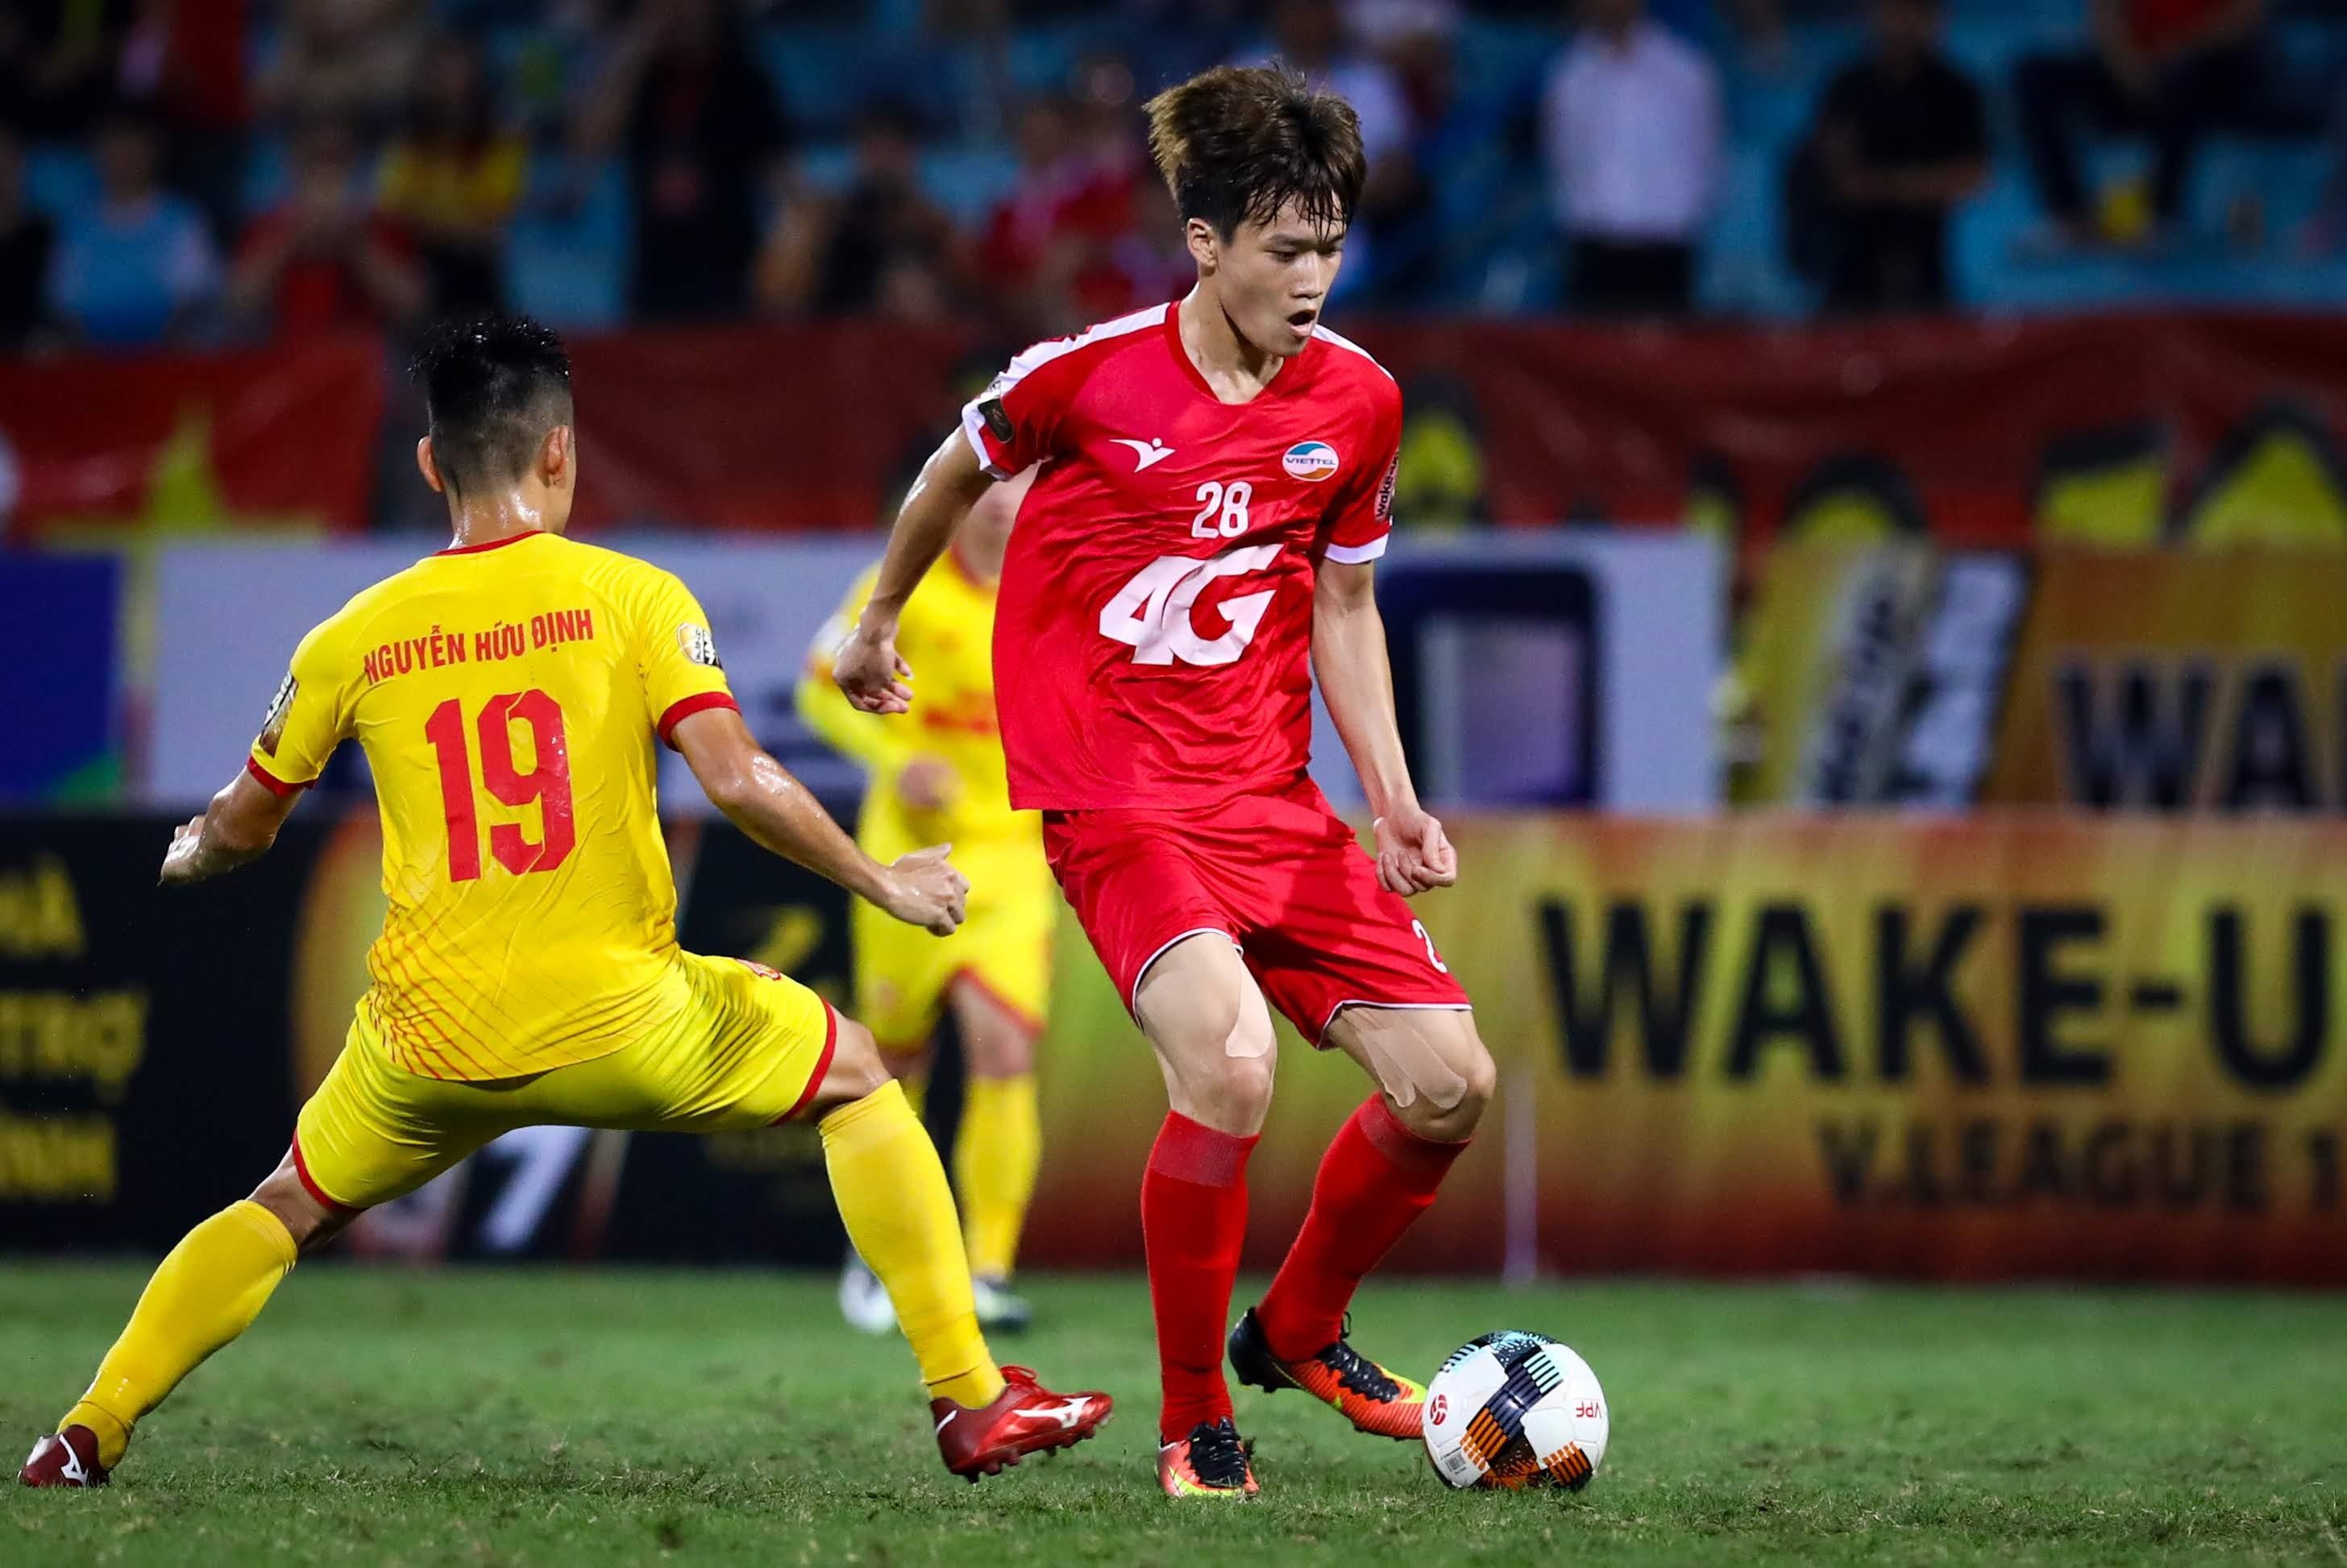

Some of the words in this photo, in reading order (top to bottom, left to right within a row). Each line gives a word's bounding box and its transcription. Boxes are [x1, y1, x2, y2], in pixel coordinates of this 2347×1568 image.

[1190, 481, 1253, 538] 28
[363, 624, 466, 686] NGUYỄN
[531, 609, 594, 653] ĐỊNH
[1099, 544, 1285, 666] 4G
[425, 689, 575, 882] 19
[2057, 665, 2347, 812] WA
[1533, 898, 2332, 1096] WAKE-U
[1817, 1118, 2266, 1213] V.LEAGUE
